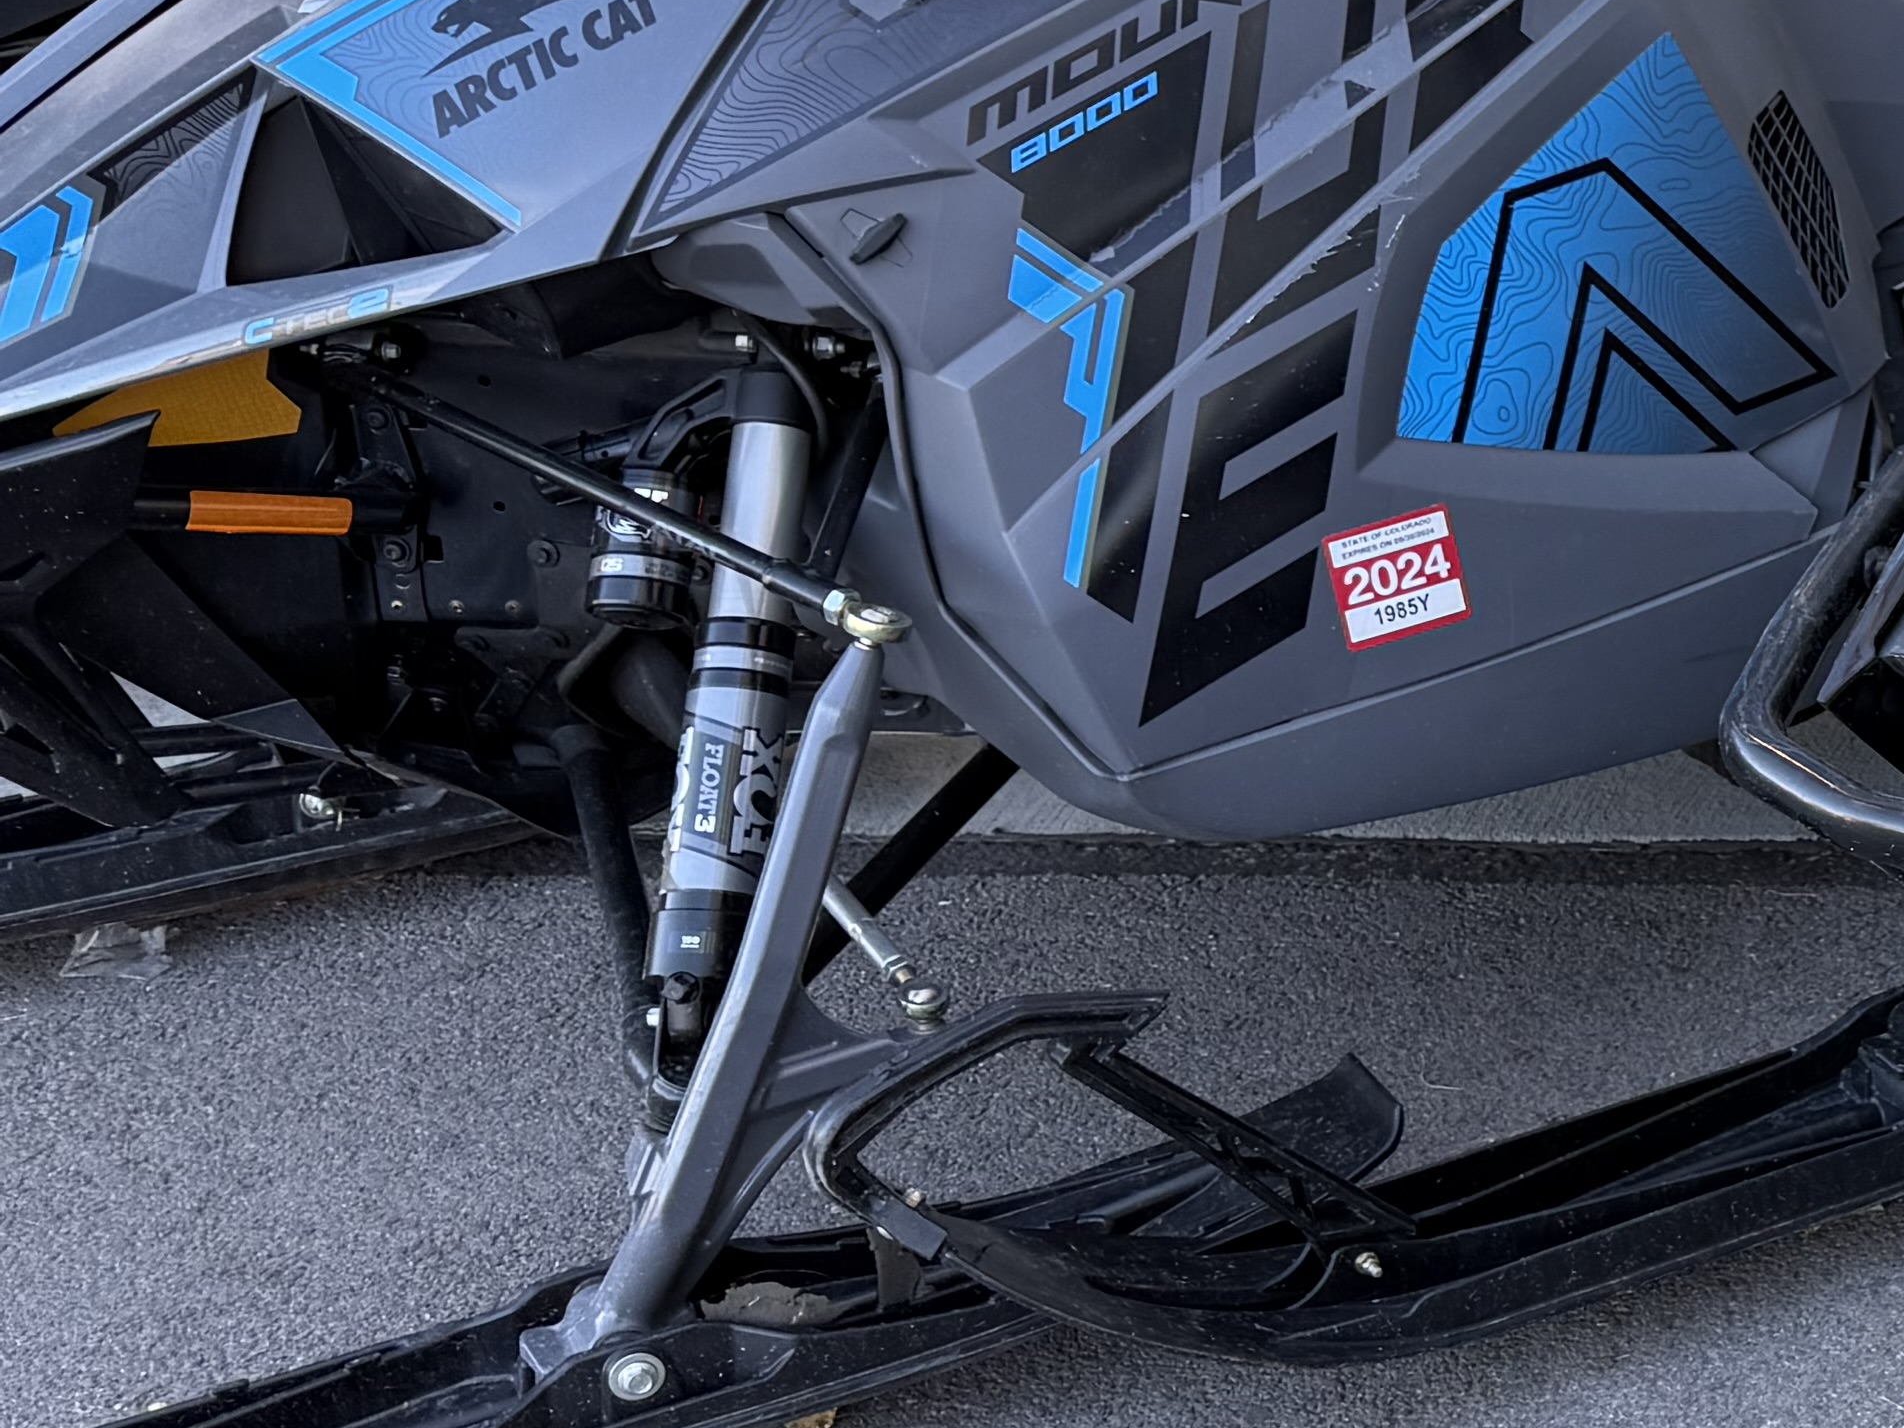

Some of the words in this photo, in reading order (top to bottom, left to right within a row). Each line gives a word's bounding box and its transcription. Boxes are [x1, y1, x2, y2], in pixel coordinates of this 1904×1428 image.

[432, 26, 579, 139] ARCTIC
[1010, 70, 1158, 173] 8000
[1343, 543, 1452, 605] 2024
[1374, 593, 1430, 625] 1985Y
